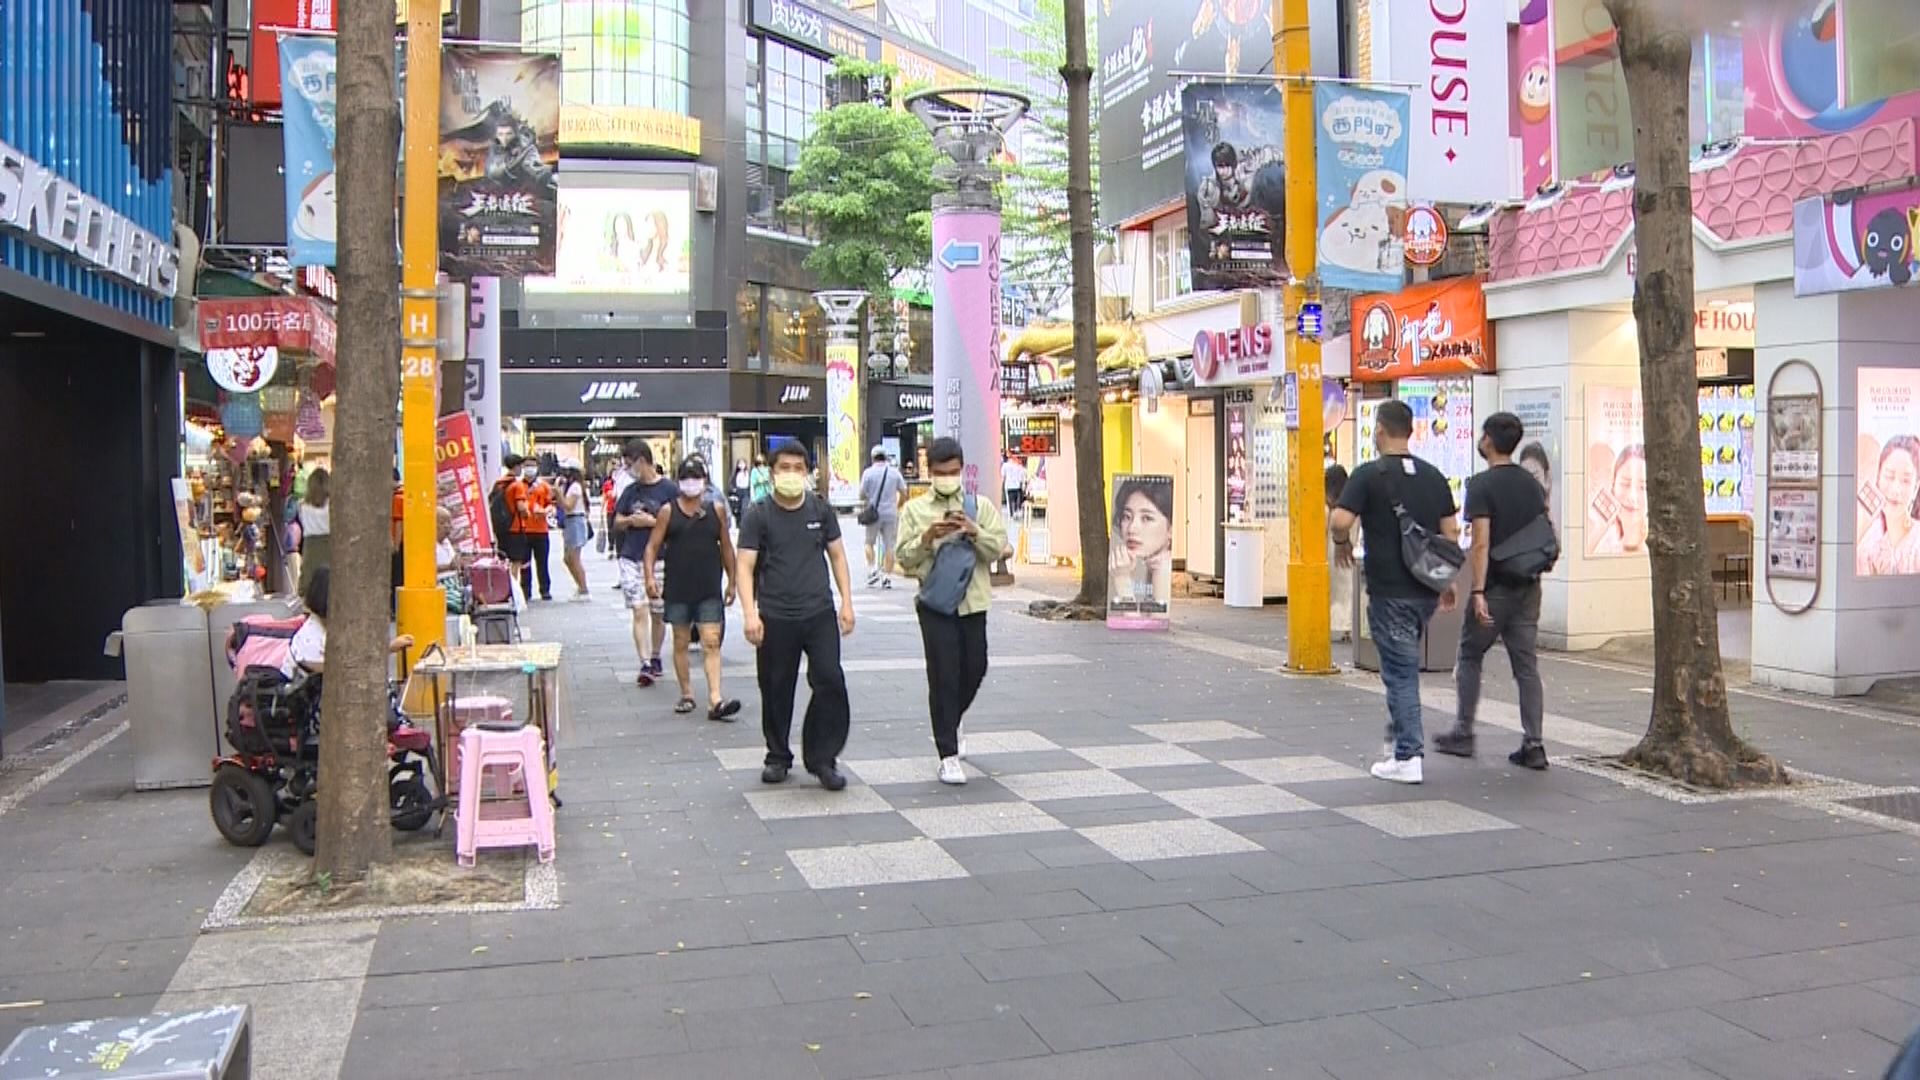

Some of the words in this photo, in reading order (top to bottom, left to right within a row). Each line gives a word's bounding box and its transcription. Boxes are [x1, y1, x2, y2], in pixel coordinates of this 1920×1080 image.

[411, 313, 428, 334] H
[987, 234, 999, 392] KOREANA
[405, 356, 433, 377] 28
[1300, 363, 1320, 380] 33
[780, 385, 810, 404] JUN
